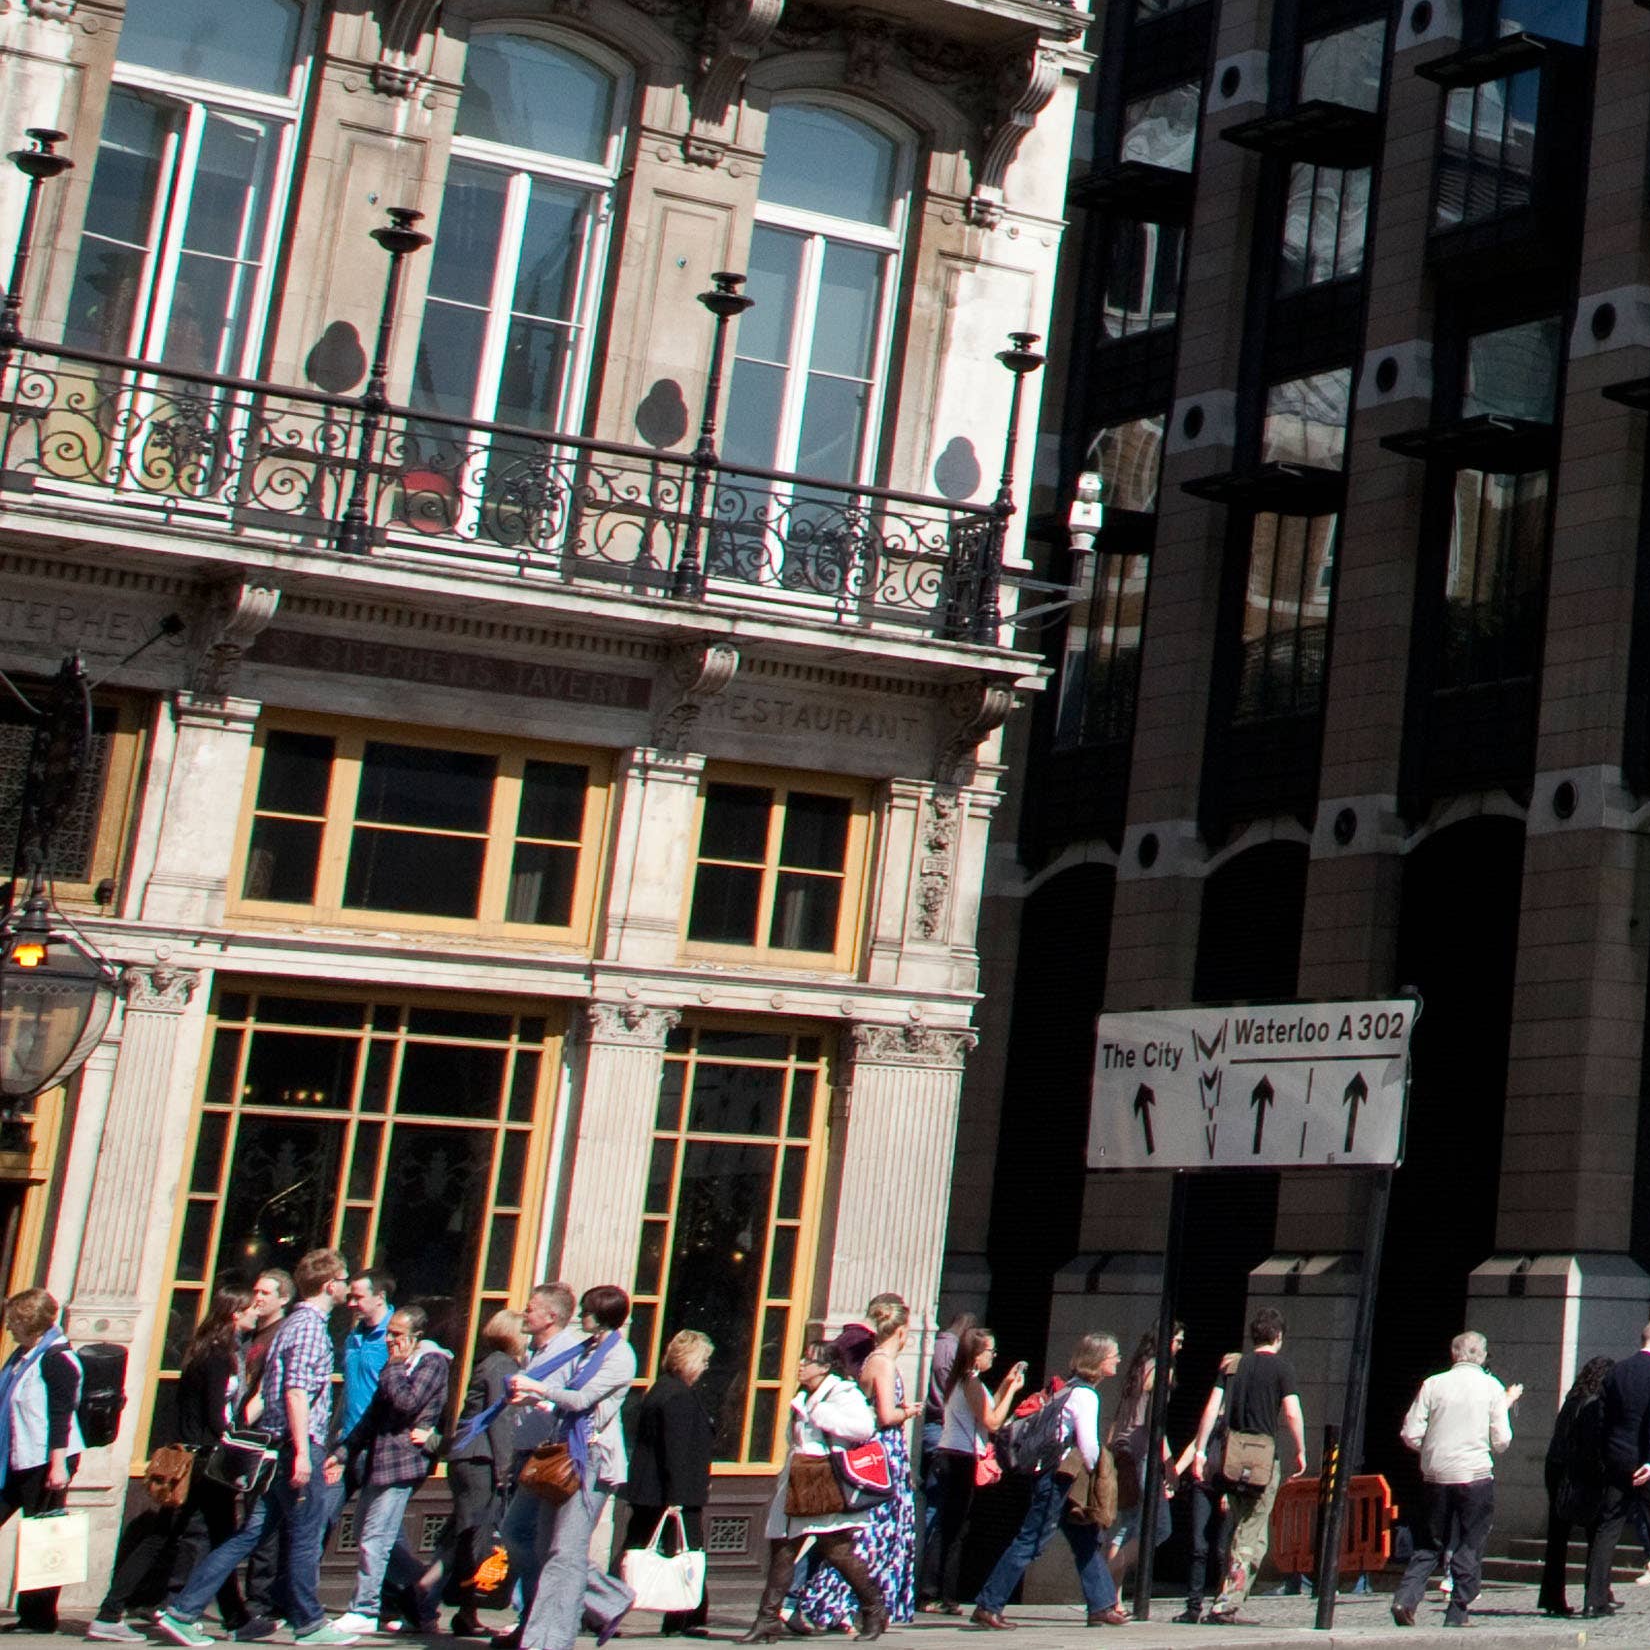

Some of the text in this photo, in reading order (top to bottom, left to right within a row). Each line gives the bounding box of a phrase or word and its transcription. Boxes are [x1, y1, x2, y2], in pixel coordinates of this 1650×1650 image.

[319, 640, 493, 687] STEPHENS
[514, 664, 628, 704] TAVERN
[706, 694, 920, 742] RESTAURANT
[1235, 1017, 1330, 1045] Waterloo
[1103, 1041, 1184, 1071] The City
